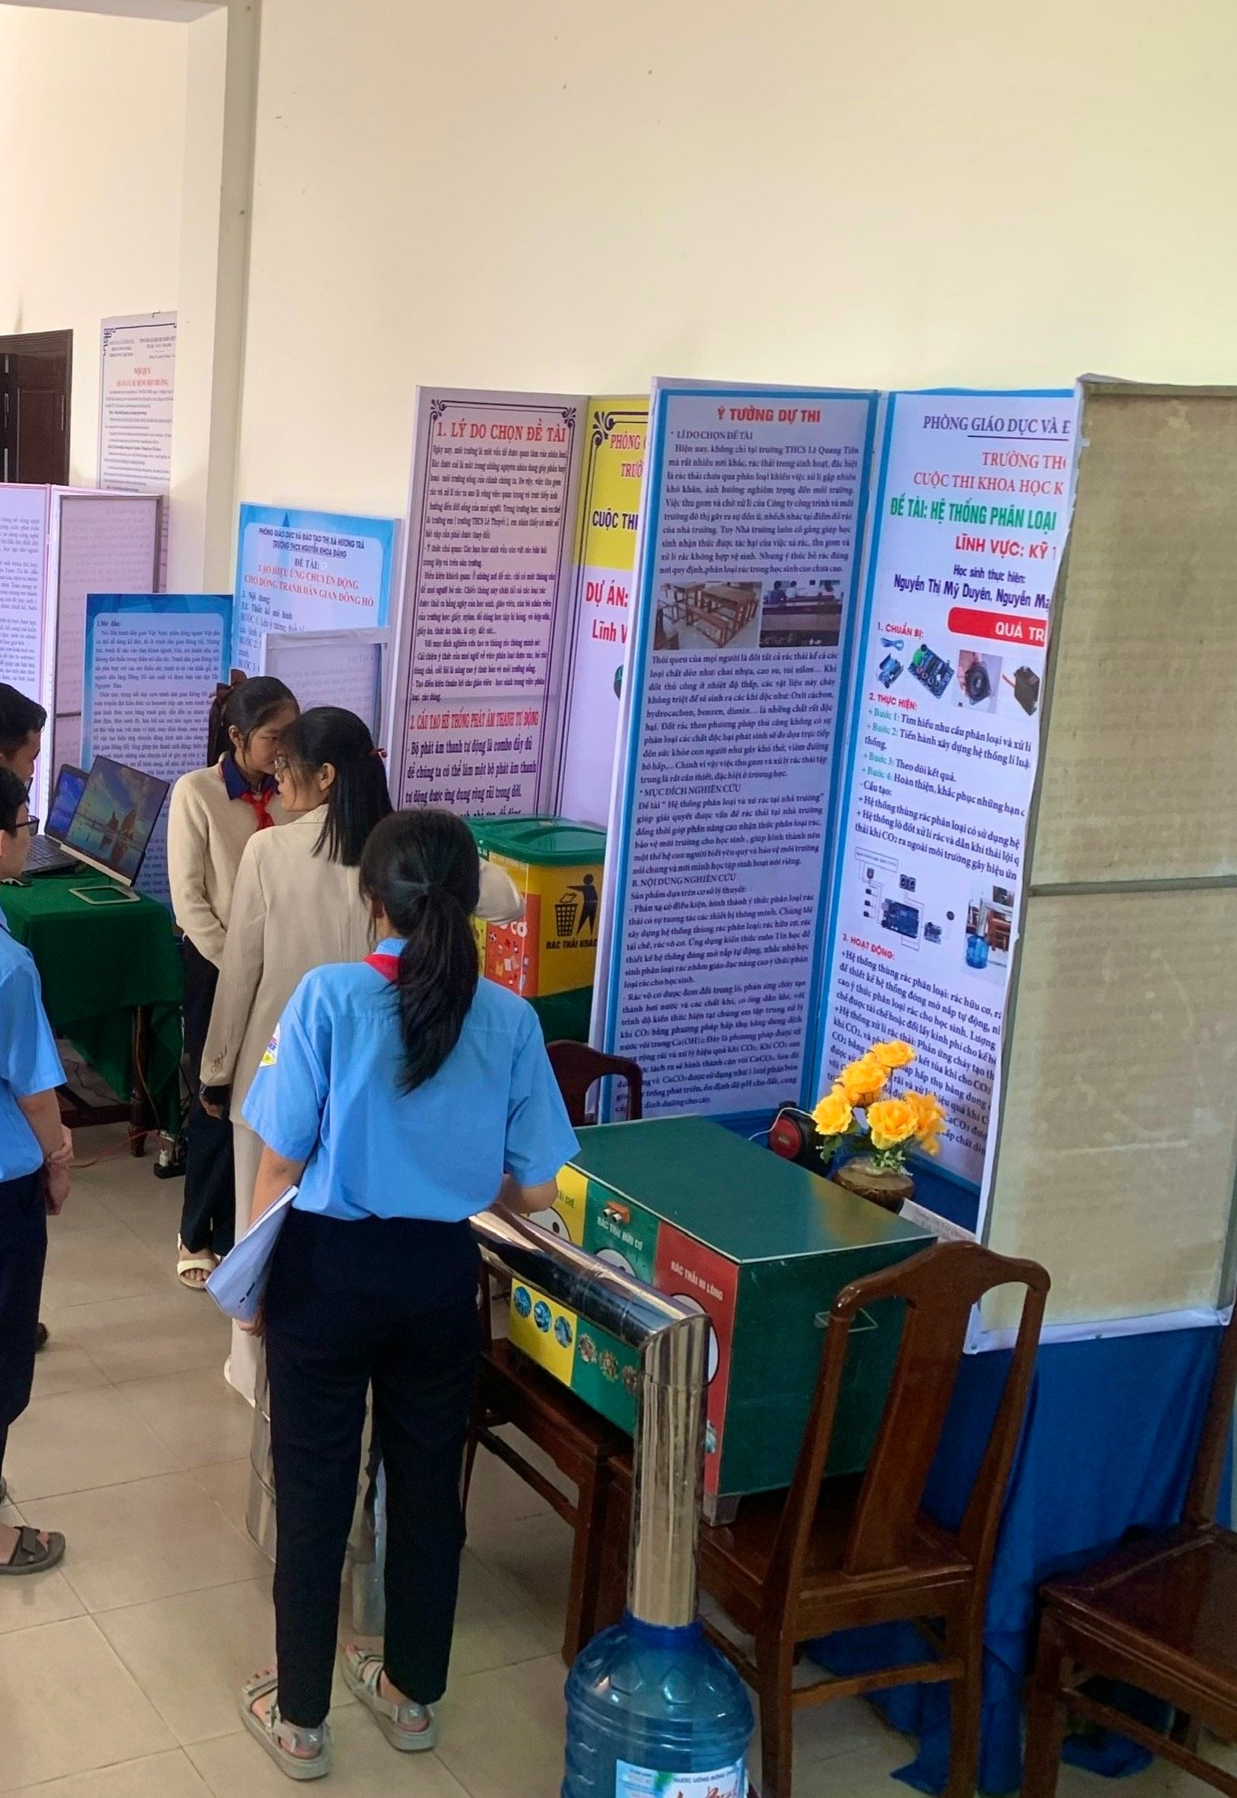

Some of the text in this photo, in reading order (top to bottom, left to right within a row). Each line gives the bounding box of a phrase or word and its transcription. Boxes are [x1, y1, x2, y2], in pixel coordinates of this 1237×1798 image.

[718, 405, 821, 425] Ý TƯỞNG DỰ THI
[923, 414, 969, 431] PHÒNG
[972, 415, 1004, 432] GIÁO
[1008, 418, 1037, 436] DỤC
[1042, 417, 1058, 434] VÀ
[437, 418, 566, 444] 1. LÝ DO CHỌN ĐỀ TÀI
[610, 431, 641, 450] PHÒNG
[982, 450, 1066, 469] TRƯỜNG TH
[914, 471, 948, 489] CUỘC
[952, 475, 974, 489] THI
[978, 478, 1014, 492] KHOA
[1020, 479, 1050, 497] HỌC
[593, 508, 638, 532] CUỘC THI
[891, 493, 1057, 535] ĐỀ TÀI: HỆ THỐNG PHÂN LOẠI
[956, 534, 985, 552] LĨNH
[990, 538, 1024, 559] VỰC:
[1029, 541, 1048, 559] KỸ
[954, 565, 1026, 584] Học sinh thực hiện:
[586, 579, 629, 608] DỰ ÁN:
[894, 574, 924, 593] Nguyễn
[928, 578, 941, 597] Thị
[943, 581, 959, 599] Mỹ
[996, 588, 1031, 608] Nguyễn
[592, 619, 616, 641] Lĩnh
[877, 622, 924, 639] 1. CHUẨN BỊ:
[995, 620, 1022, 638] QUÁ
[869, 693, 917, 711] 2. THỰC HIỆN:
[874, 708, 892, 720] Bước
[901, 714, 916, 725] Tìm
[935, 722, 950, 733] nhu
[965, 729, 985, 741] phân
[987, 733, 1002, 747] loại
[1004, 738, 1012, 747] và
[896, 759, 913, 771] Theo
[928, 766, 939, 778] kết
[851, 937, 870, 951] HOẠT
[871, 944, 895, 960] ĐỘNG:
[671, 1261, 683, 1275] RÁC
[707, 1281, 723, 1301] LÔNG
